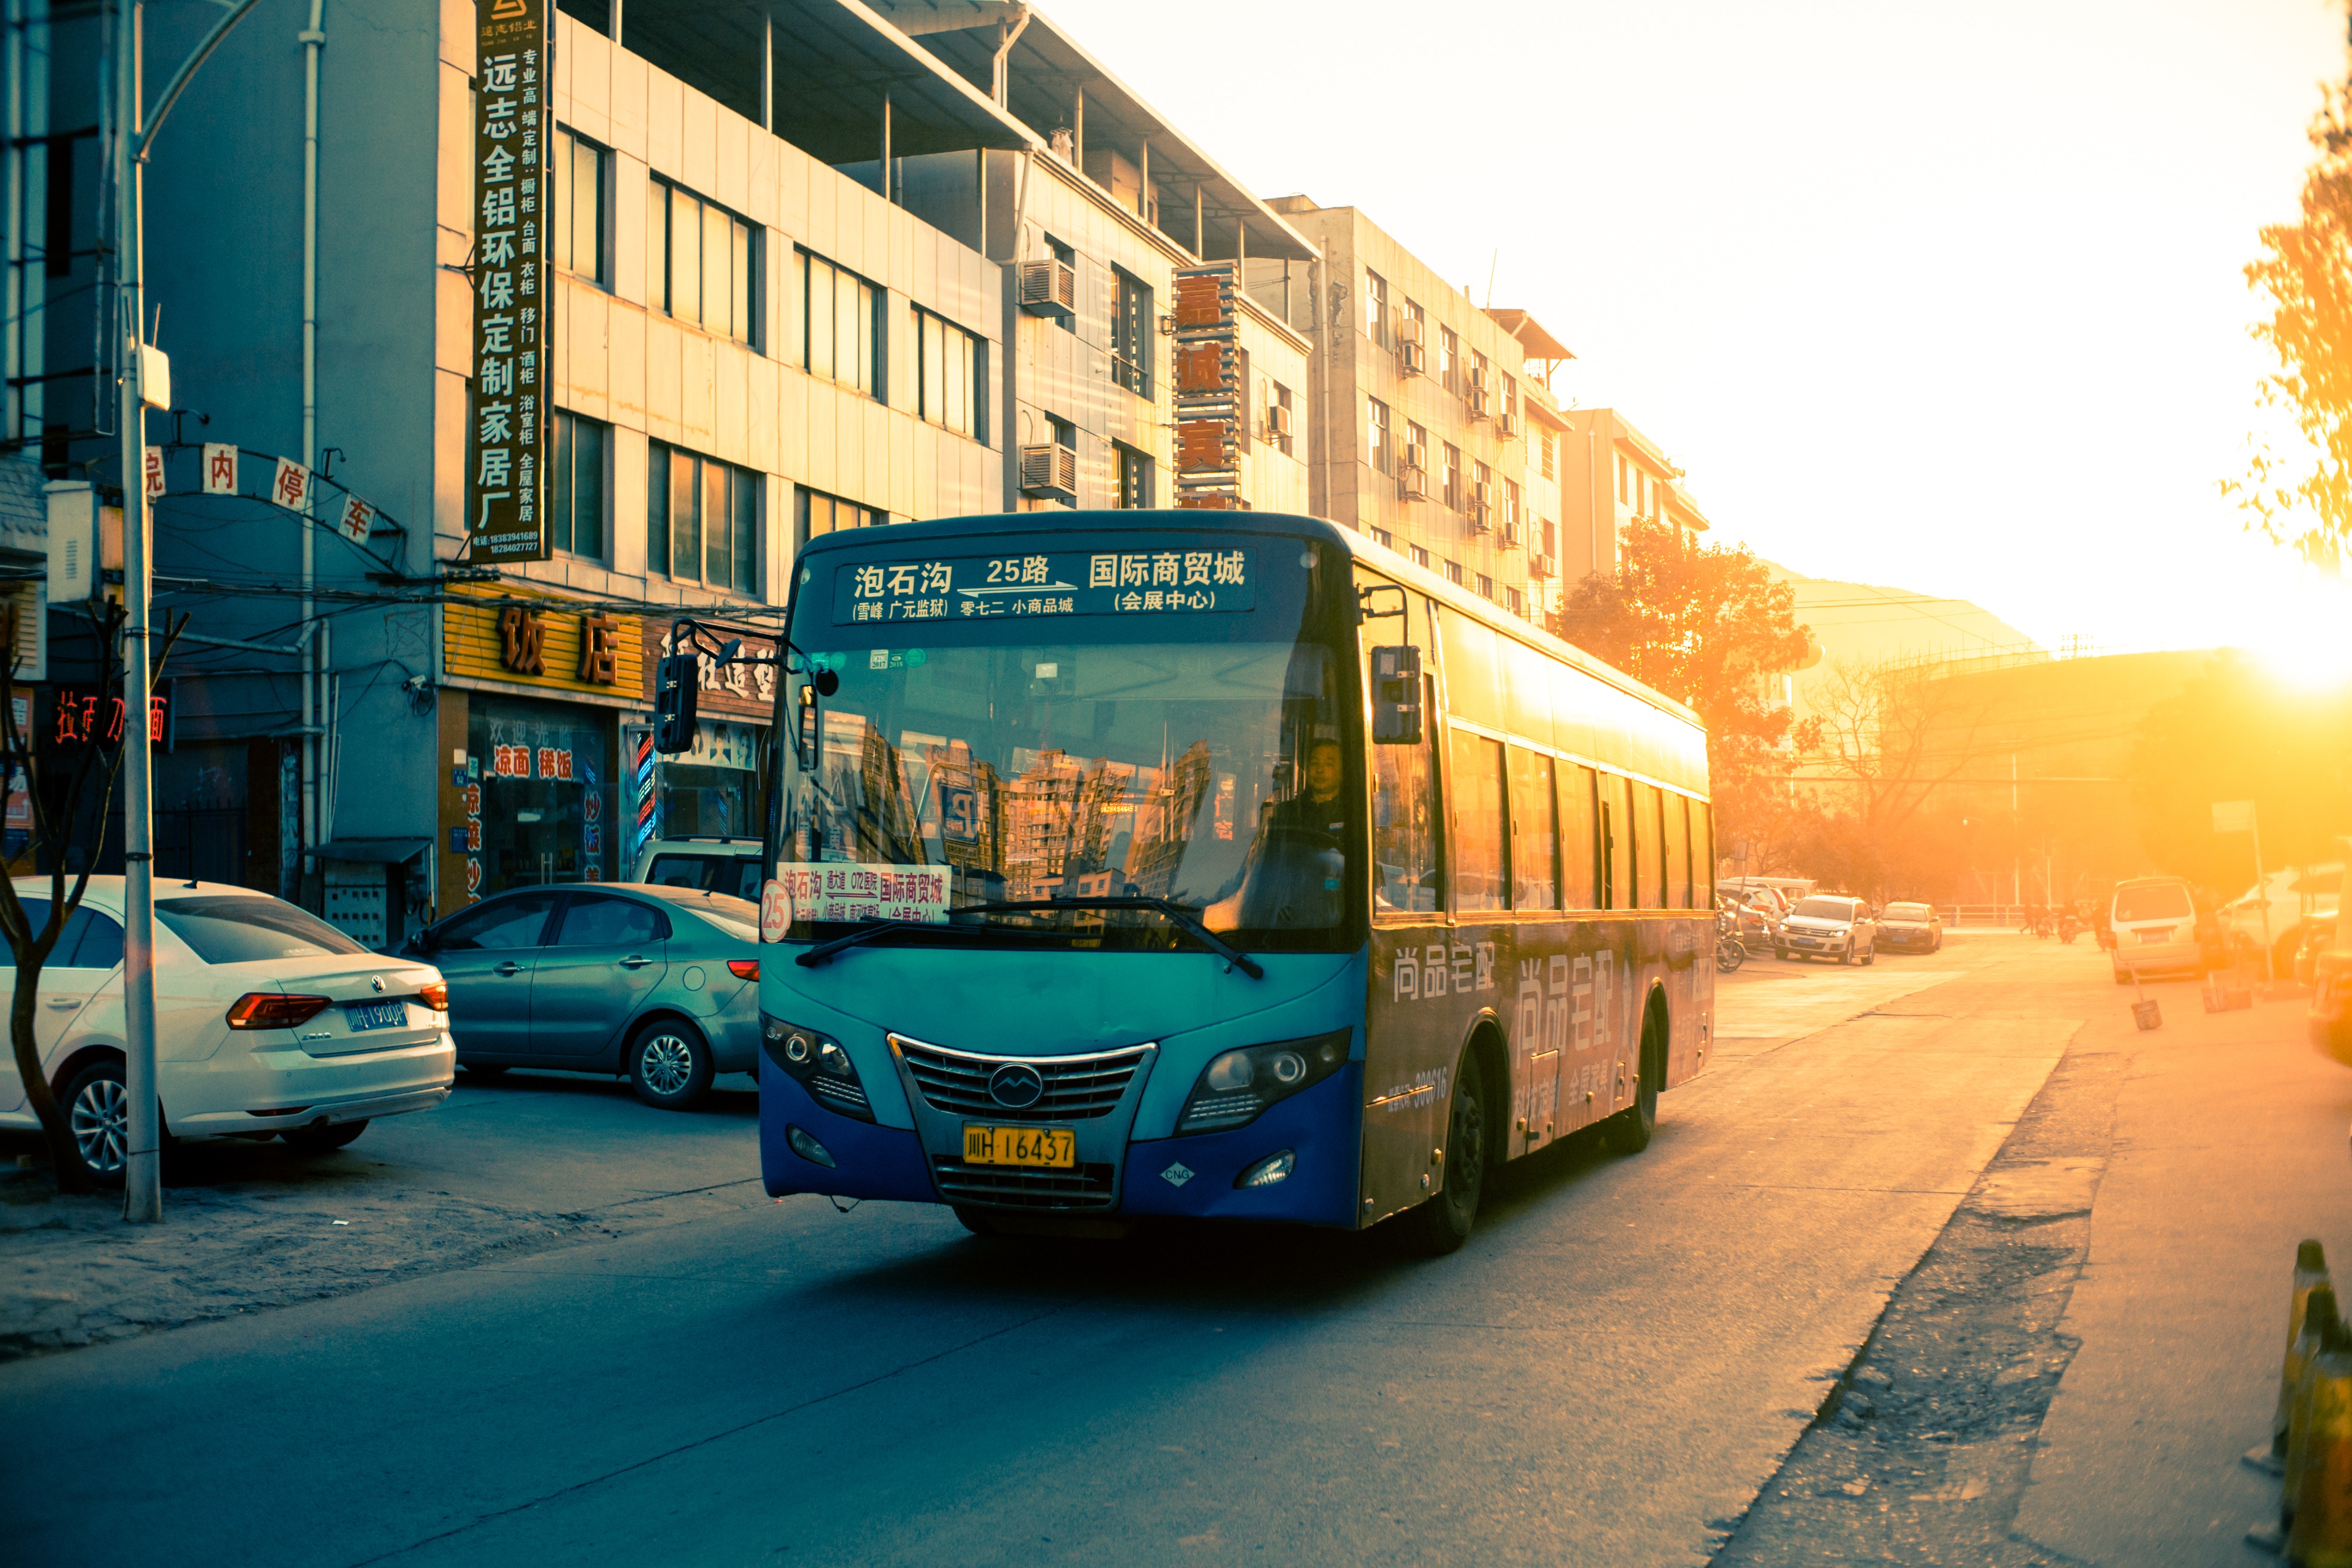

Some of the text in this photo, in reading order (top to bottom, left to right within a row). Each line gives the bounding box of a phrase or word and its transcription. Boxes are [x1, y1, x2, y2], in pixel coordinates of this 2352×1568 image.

[522, 220, 535, 254] 台面
[479, 53, 517, 529] 远志全铝环保定制家居厂
[520, 262, 535, 295] 衣柜
[520, 307, 536, 343] 移门
[519, 350, 535, 384] 酒柜
[519, 395, 535, 445] 浴室柜
[519, 452, 535, 522] 全屋家居
[853, 551, 1245, 598] 泡石沟 25路 国际商贸城
[960, 599, 1004, 616] 零七二
[1012, 597, 1074, 615] 小商品城
[1114, 590, 1216, 612] (会展中心)
[498, 607, 619, 685] 饭店
[494, 744, 572, 780] 凉面 稀饭
[785, 869, 823, 900] 泡石沟
[880, 872, 943, 904] 国际商贸城
[762, 893, 785, 929] 25
[1394, 941, 1495, 1003] 尚品宅配
[1517, 949, 1613, 1070] 尚品宅配
[1414, 1065, 1447, 1108] 300616
[1165, 1169, 1190, 1181] CNG
